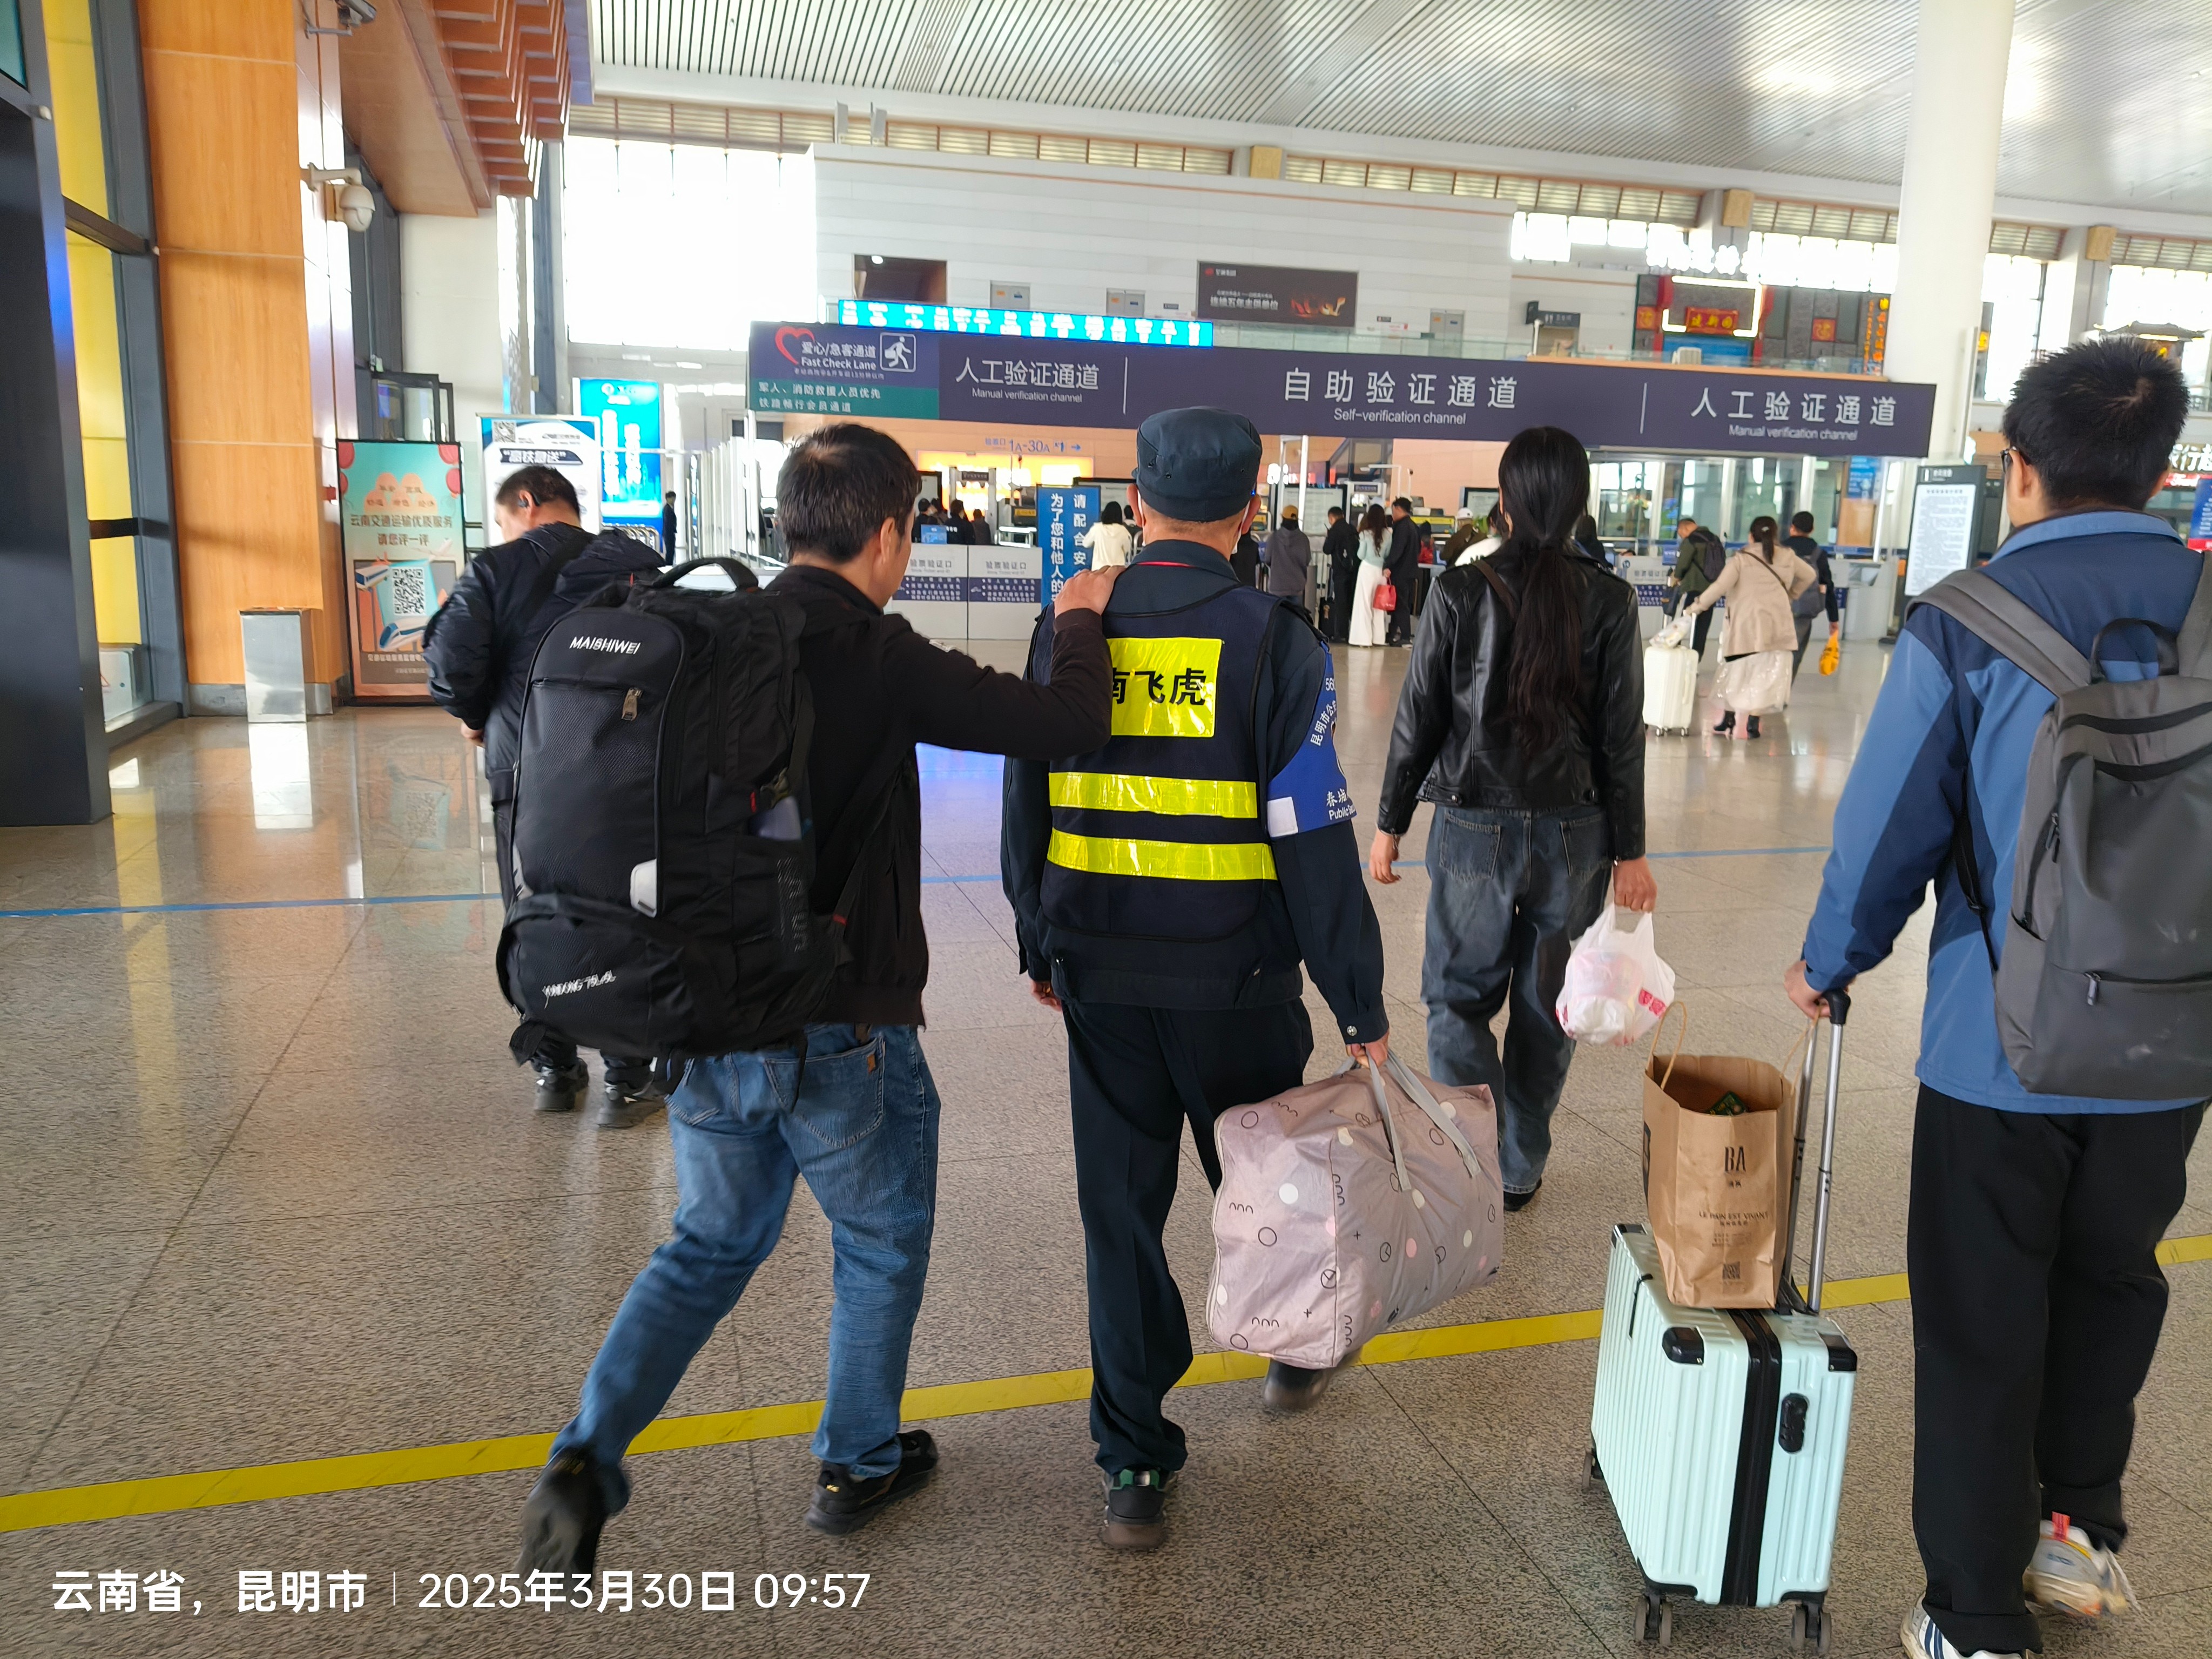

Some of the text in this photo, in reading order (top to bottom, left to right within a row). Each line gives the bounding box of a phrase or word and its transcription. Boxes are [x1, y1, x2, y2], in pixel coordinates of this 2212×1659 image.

[801, 357, 876, 370] Fast Check Lane
[955, 356, 1099, 390] 人工验证通道
[972, 388, 1082, 403] Manual verification channel
[1285, 367, 1518, 409] 自助验证通道
[1691, 387, 1896, 426] 人工验证通道
[1333, 407, 1466, 425] Self-verification channel
[1729, 424, 1858, 441] Manual verification channel
[1009, 439, 1050, 453] 1A-30A
[1074, 494, 1087, 577] 请配合安
[1050, 493, 1064, 602] 为了您和他人的
[569, 636, 641, 655] MAISHIWEI
[1326, 678, 1336, 691] 56
[1328, 807, 1349, 821] Public
